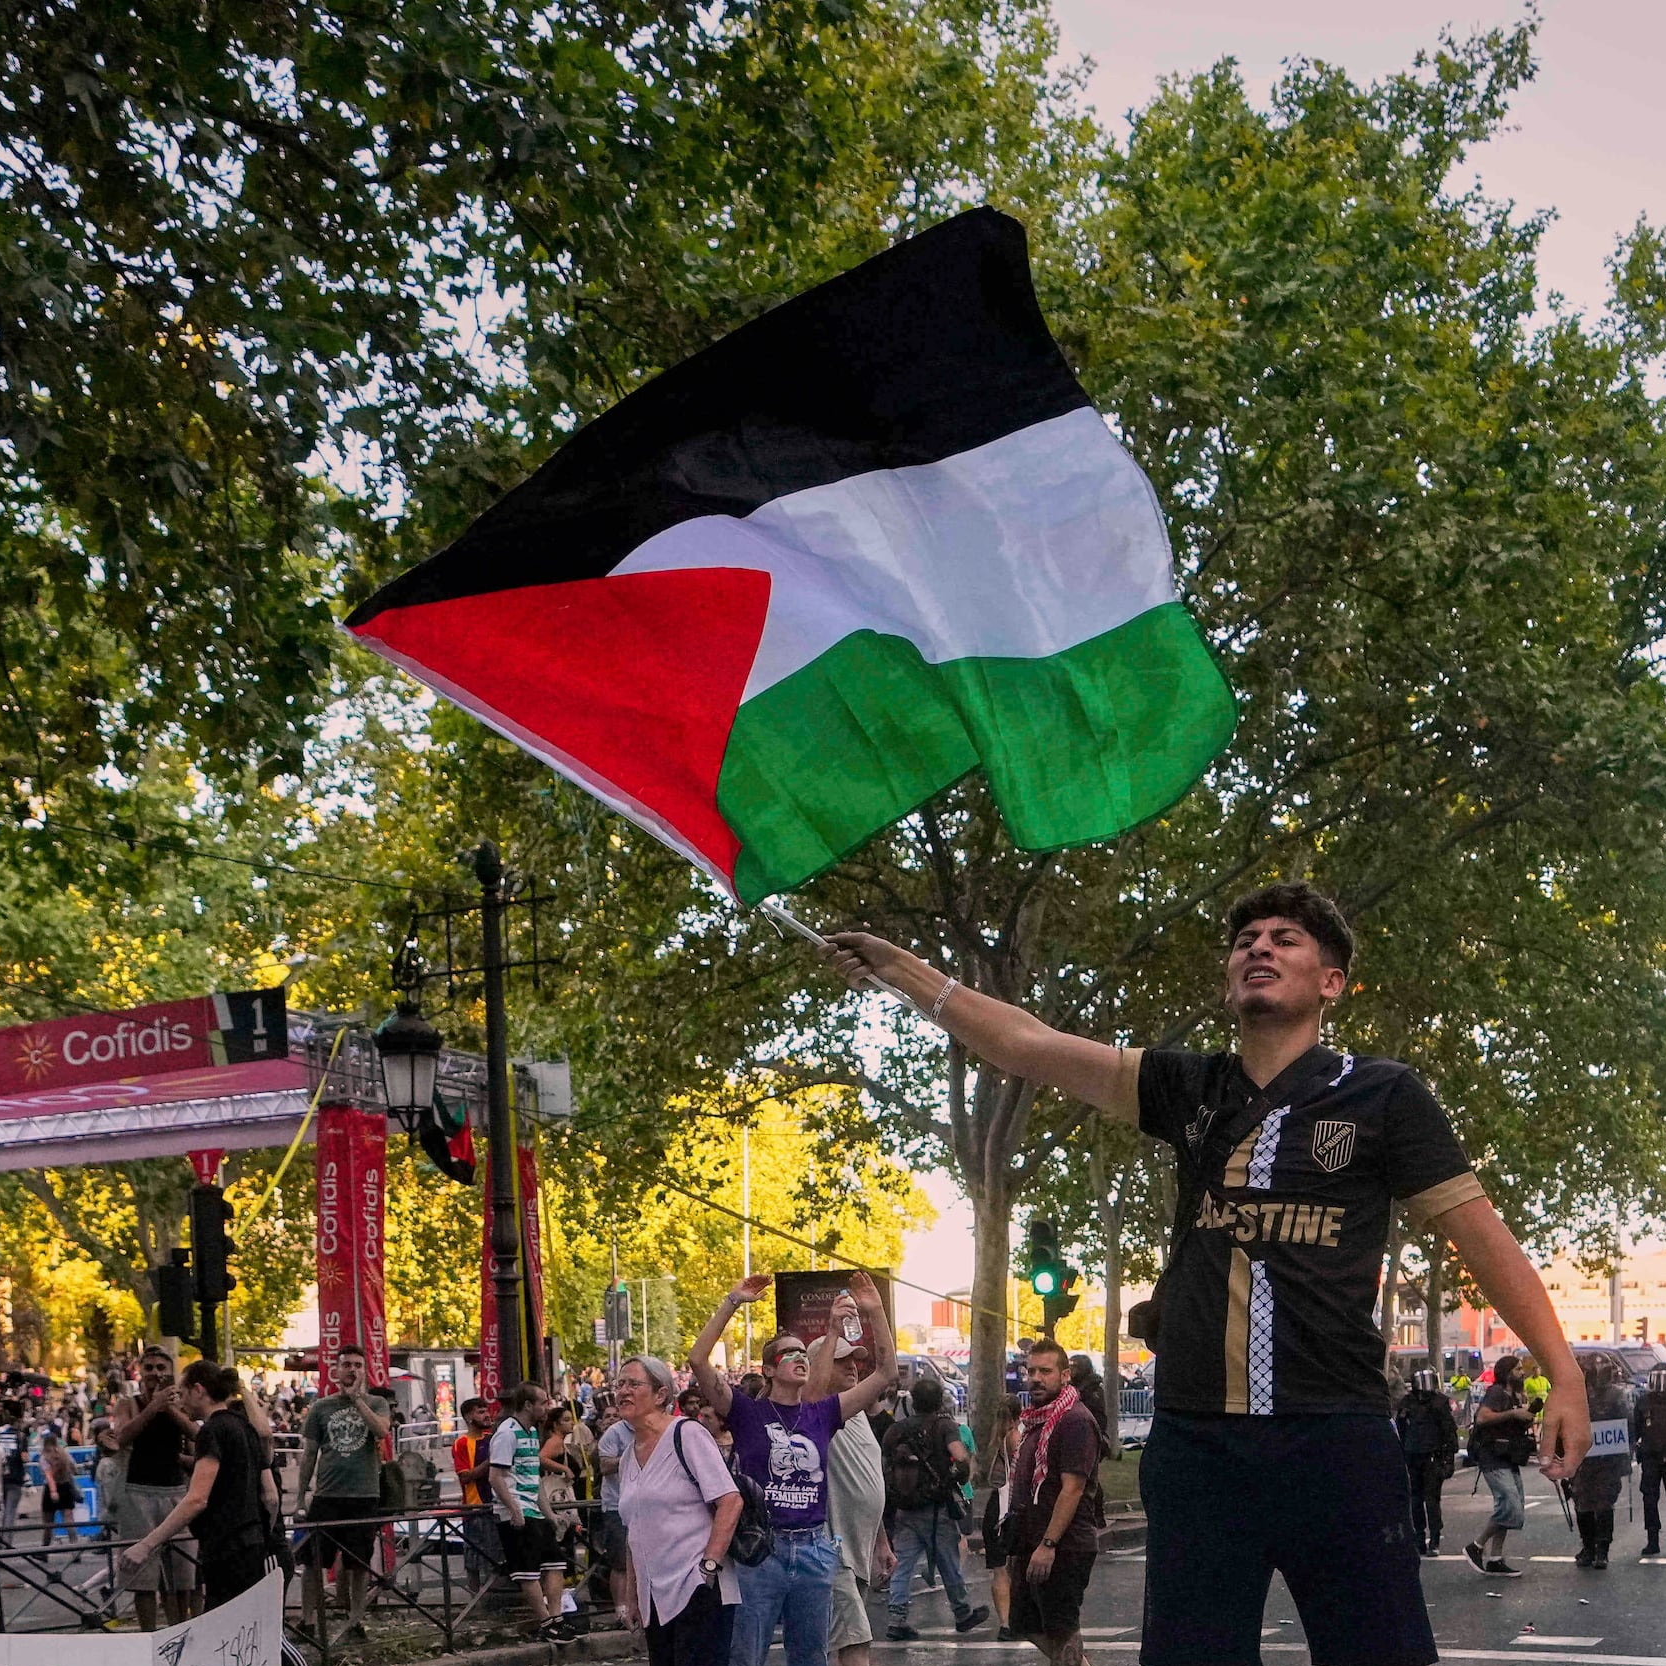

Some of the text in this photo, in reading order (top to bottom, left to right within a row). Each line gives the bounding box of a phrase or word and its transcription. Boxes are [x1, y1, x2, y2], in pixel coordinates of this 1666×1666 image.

[251, 998, 268, 1035] 1
[62, 1016, 194, 1066] Cofidis
[1324, 1125, 1353, 1151] PALESTINA
[320, 1161, 338, 1255] Cofidis
[364, 1168, 379, 1260] Cofidis
[483, 1322, 499, 1405] Cofidis
[1593, 1429, 1626, 1446] LICIA
[779, 1482, 801, 1492] lucha
